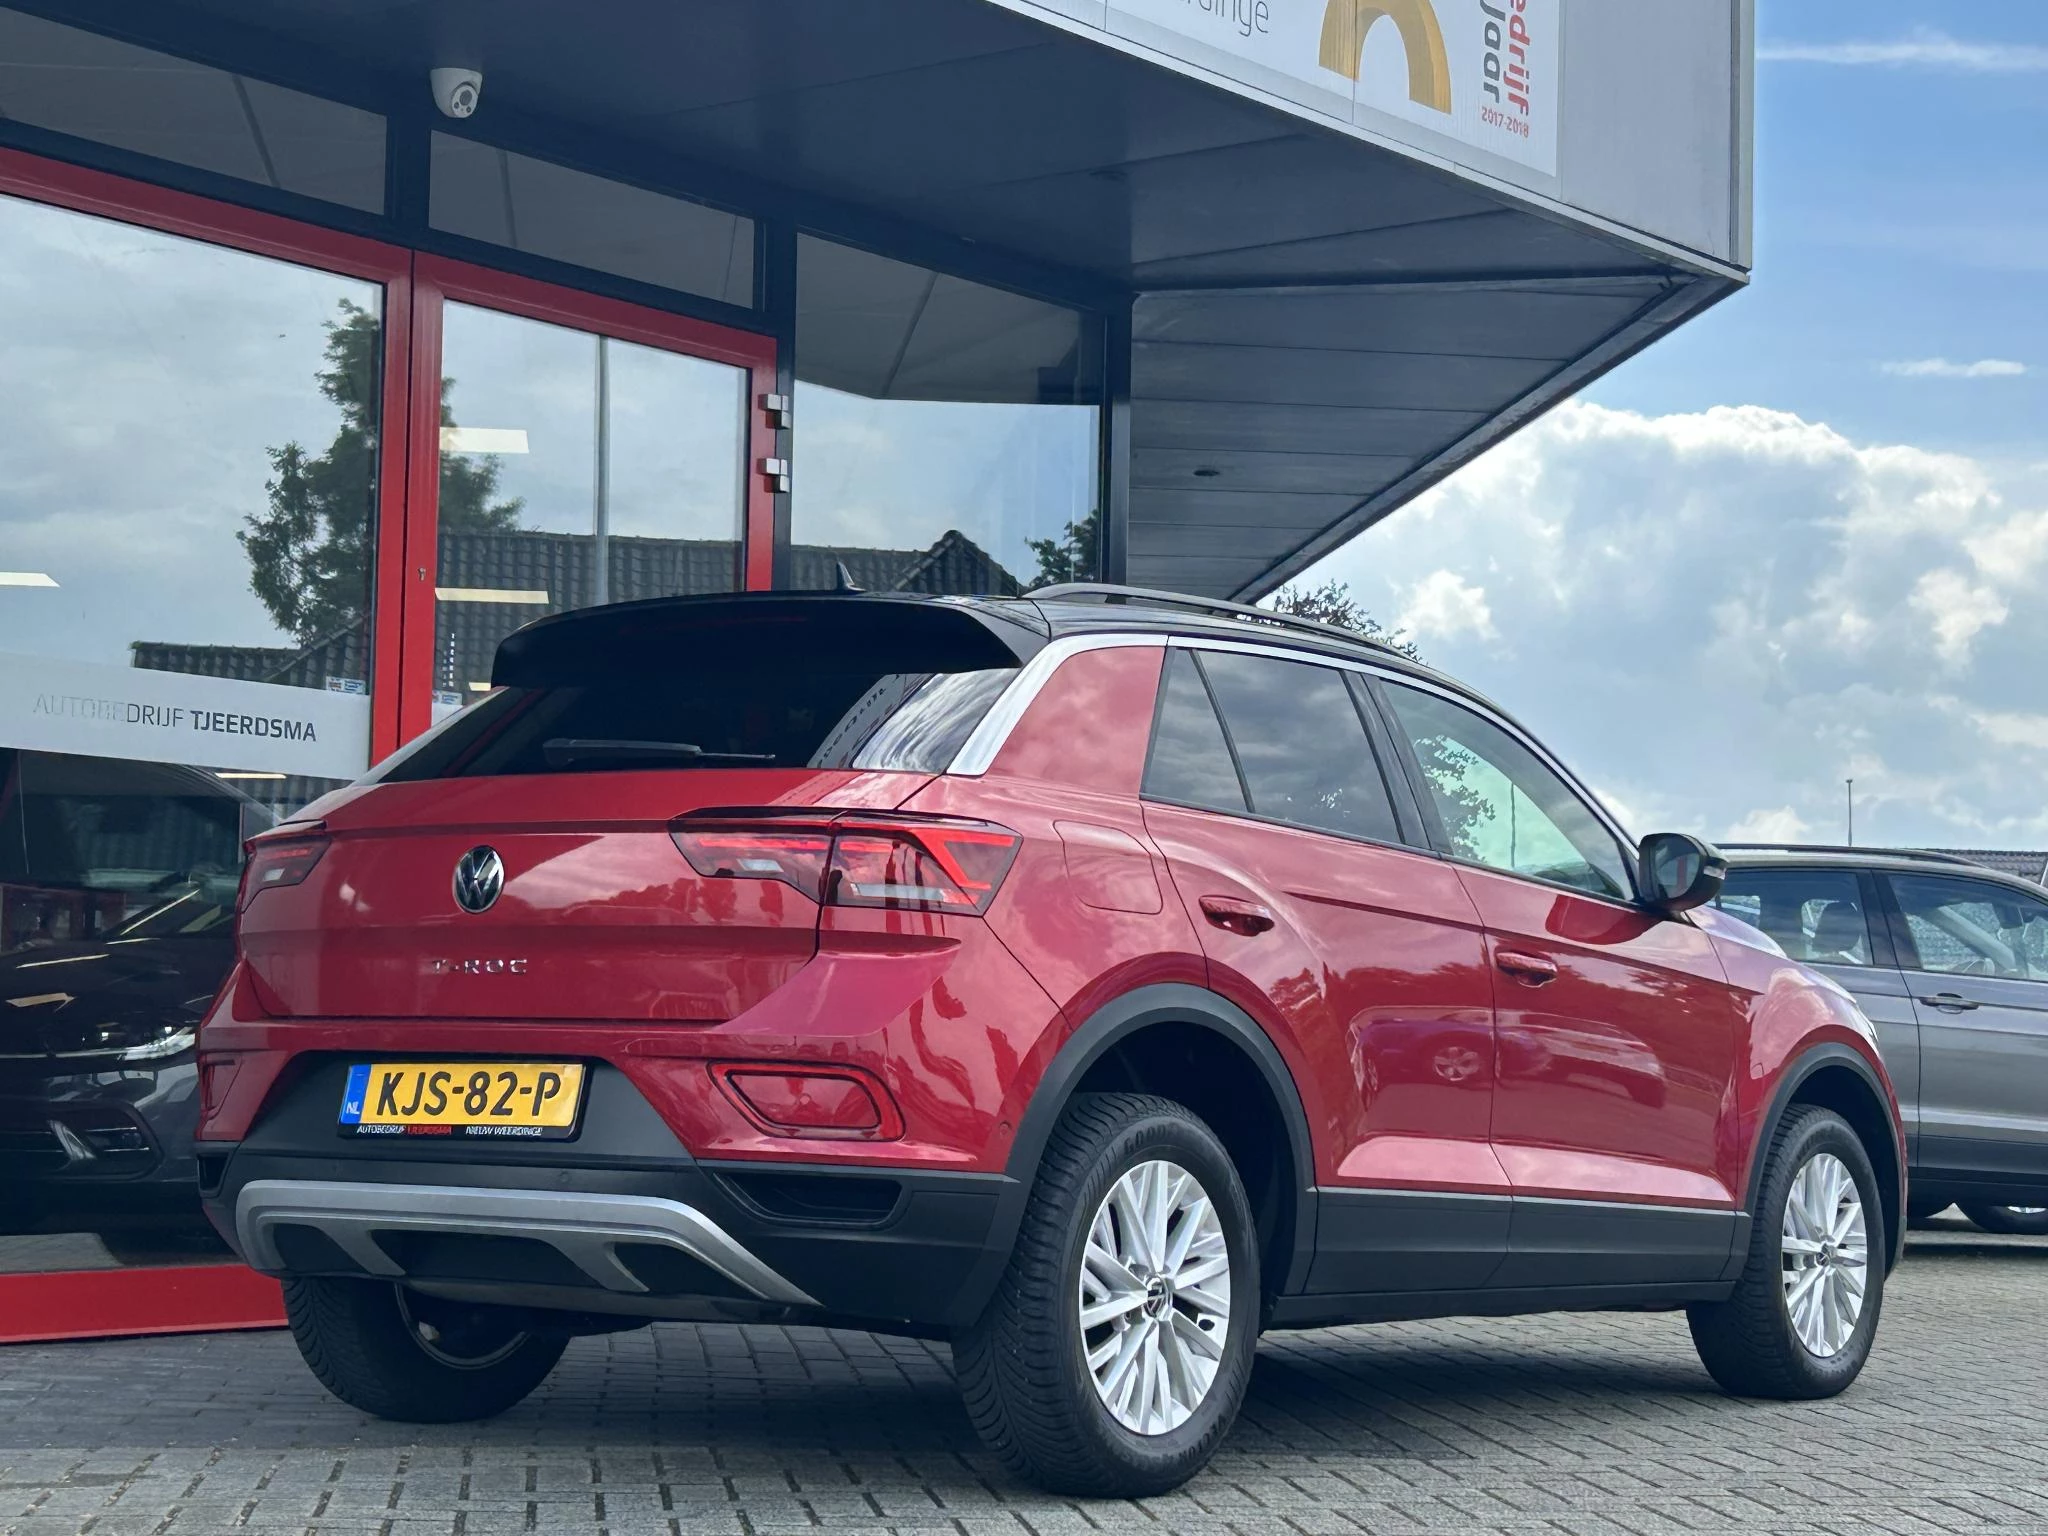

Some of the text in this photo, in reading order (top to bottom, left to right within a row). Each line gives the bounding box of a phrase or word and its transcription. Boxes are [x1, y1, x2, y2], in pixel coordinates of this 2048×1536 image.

[1481, 106, 1529, 138] 2017-2018
[190, 710, 317, 742] TJEERDSMA
[376, 1071, 561, 1117] KJS-82-P
